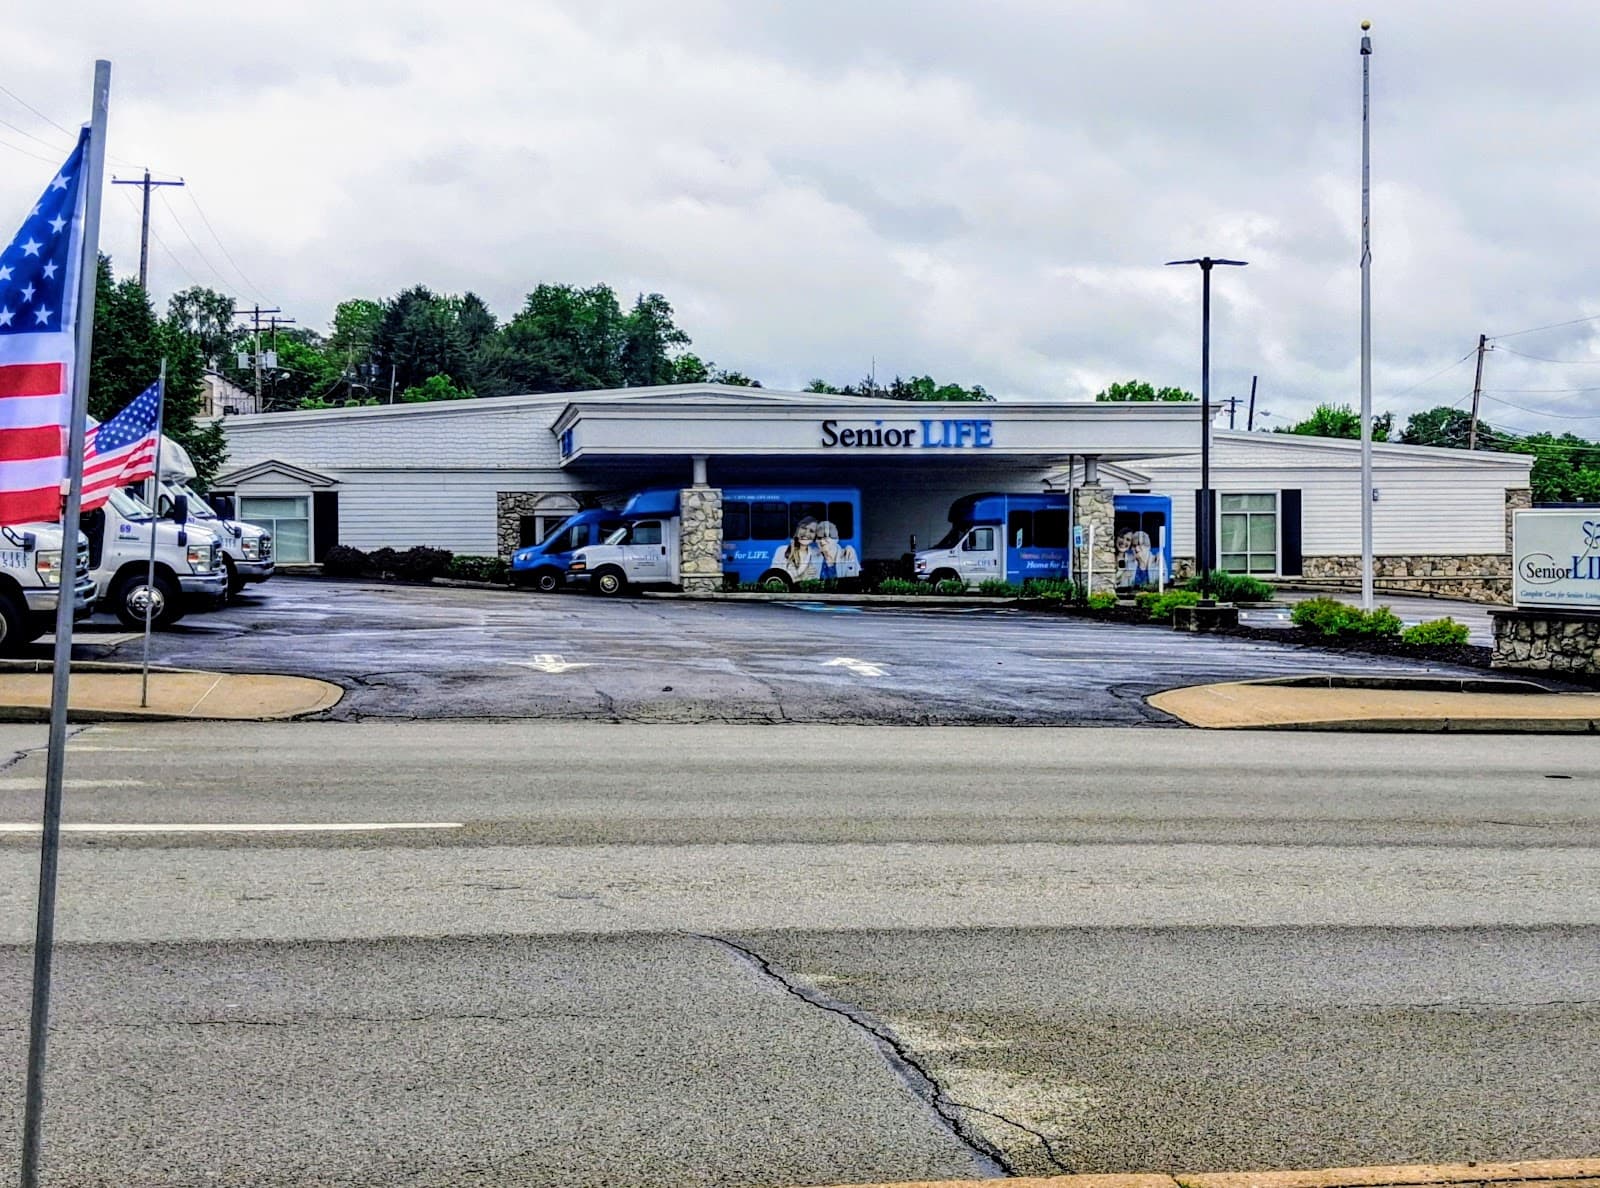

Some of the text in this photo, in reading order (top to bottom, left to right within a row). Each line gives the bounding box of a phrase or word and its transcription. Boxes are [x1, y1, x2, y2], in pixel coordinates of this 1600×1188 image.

[821, 419, 993, 449] Senior LIFE
[735, 550, 747, 560] for
[1026, 560, 1049, 569] Home
[1526, 555, 1600, 580] Senior LI
